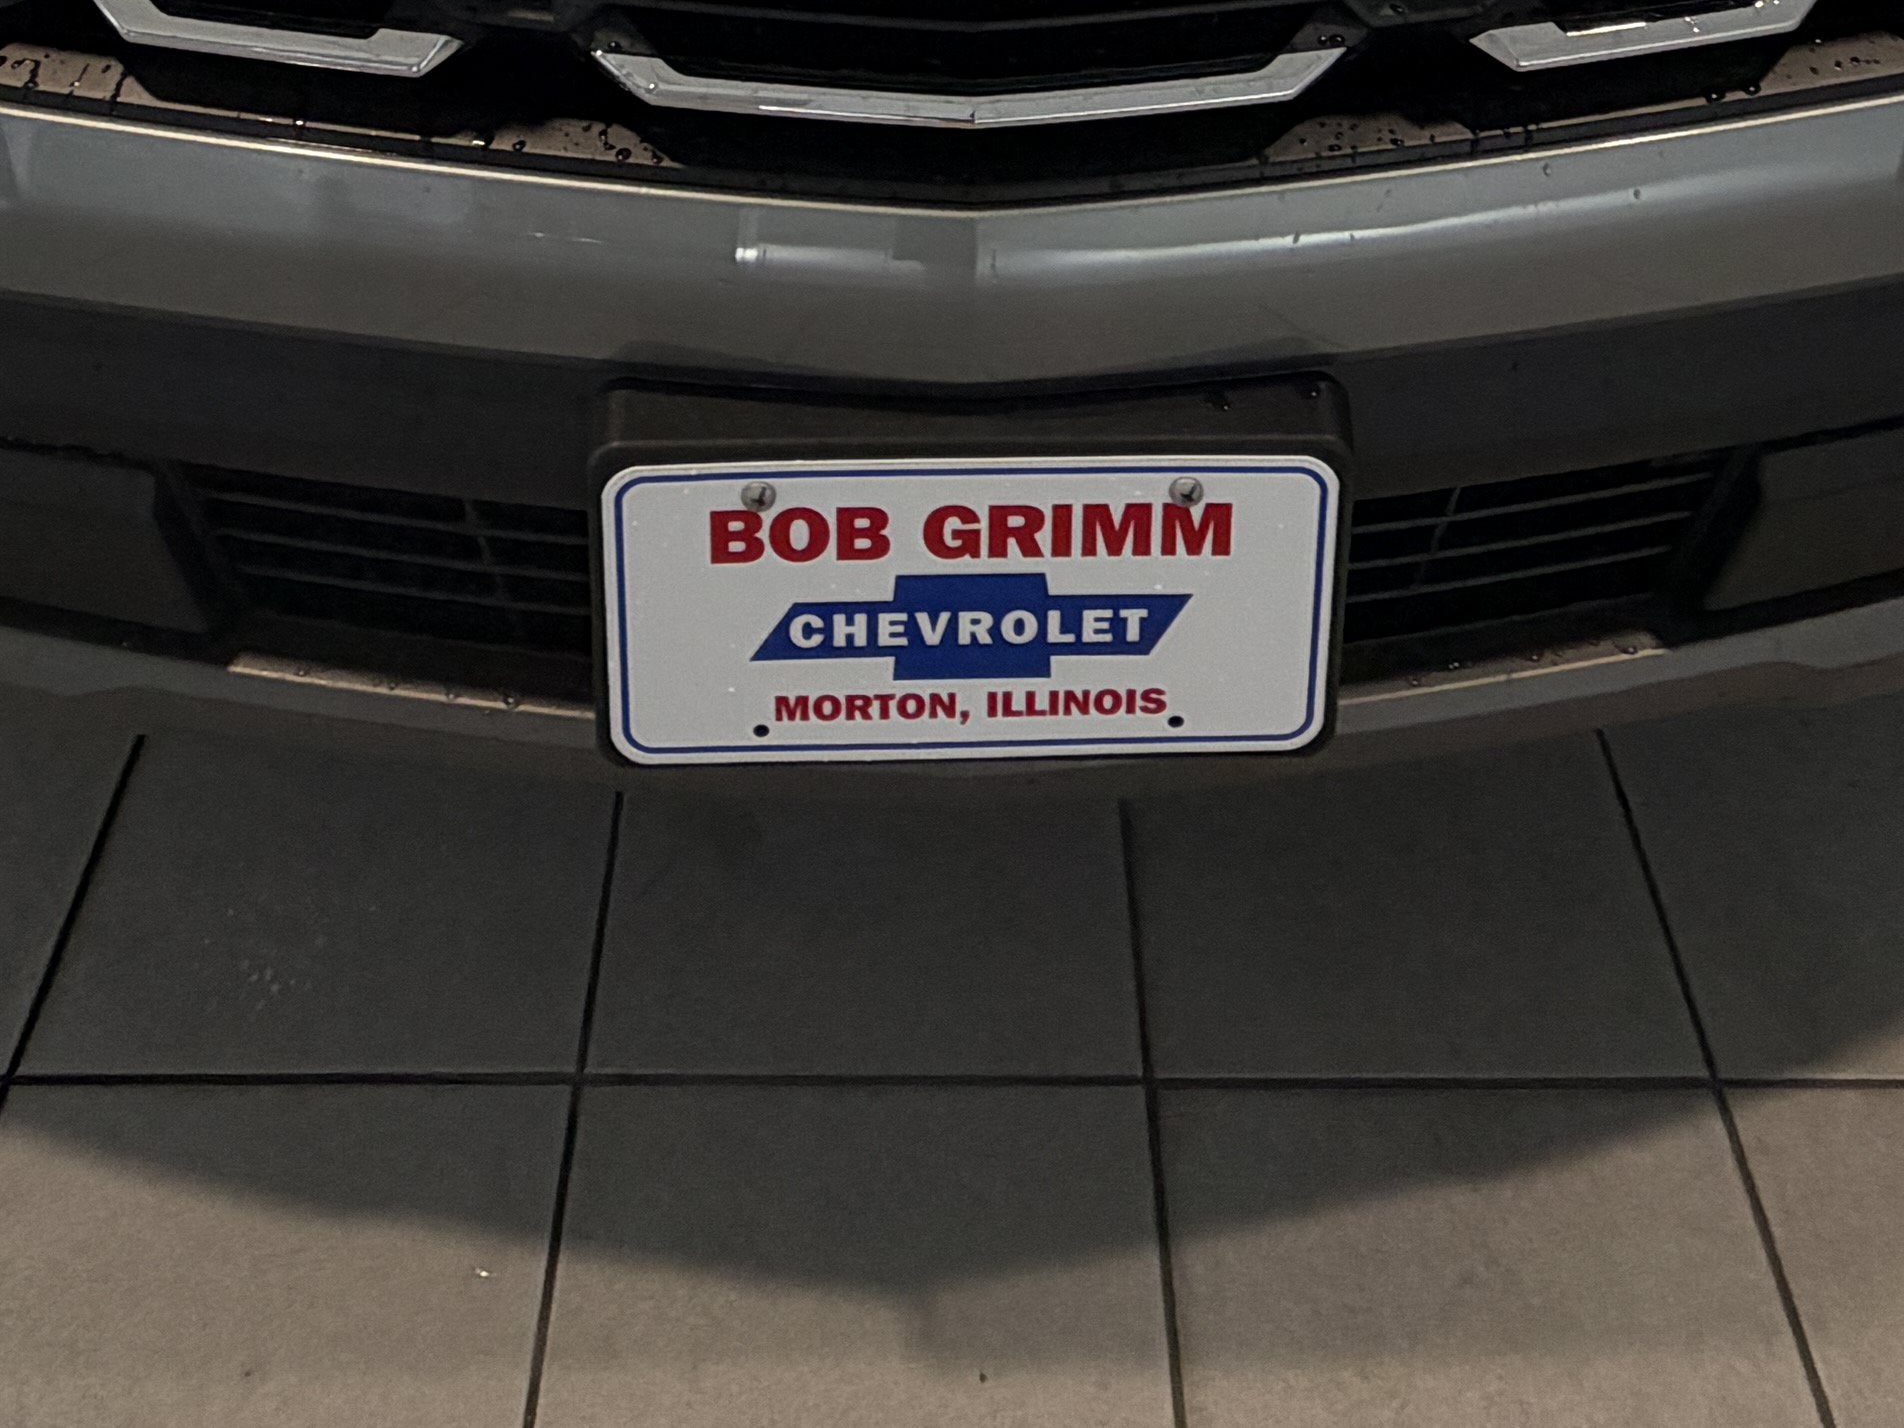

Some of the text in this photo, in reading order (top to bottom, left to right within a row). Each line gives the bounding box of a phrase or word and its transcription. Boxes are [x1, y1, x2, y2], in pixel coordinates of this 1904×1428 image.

[709, 502, 1233, 564] BOB GRIMM
[788, 608, 1149, 649] CHEVROLET
[774, 688, 1168, 725] MORTON, ILLINOIS
